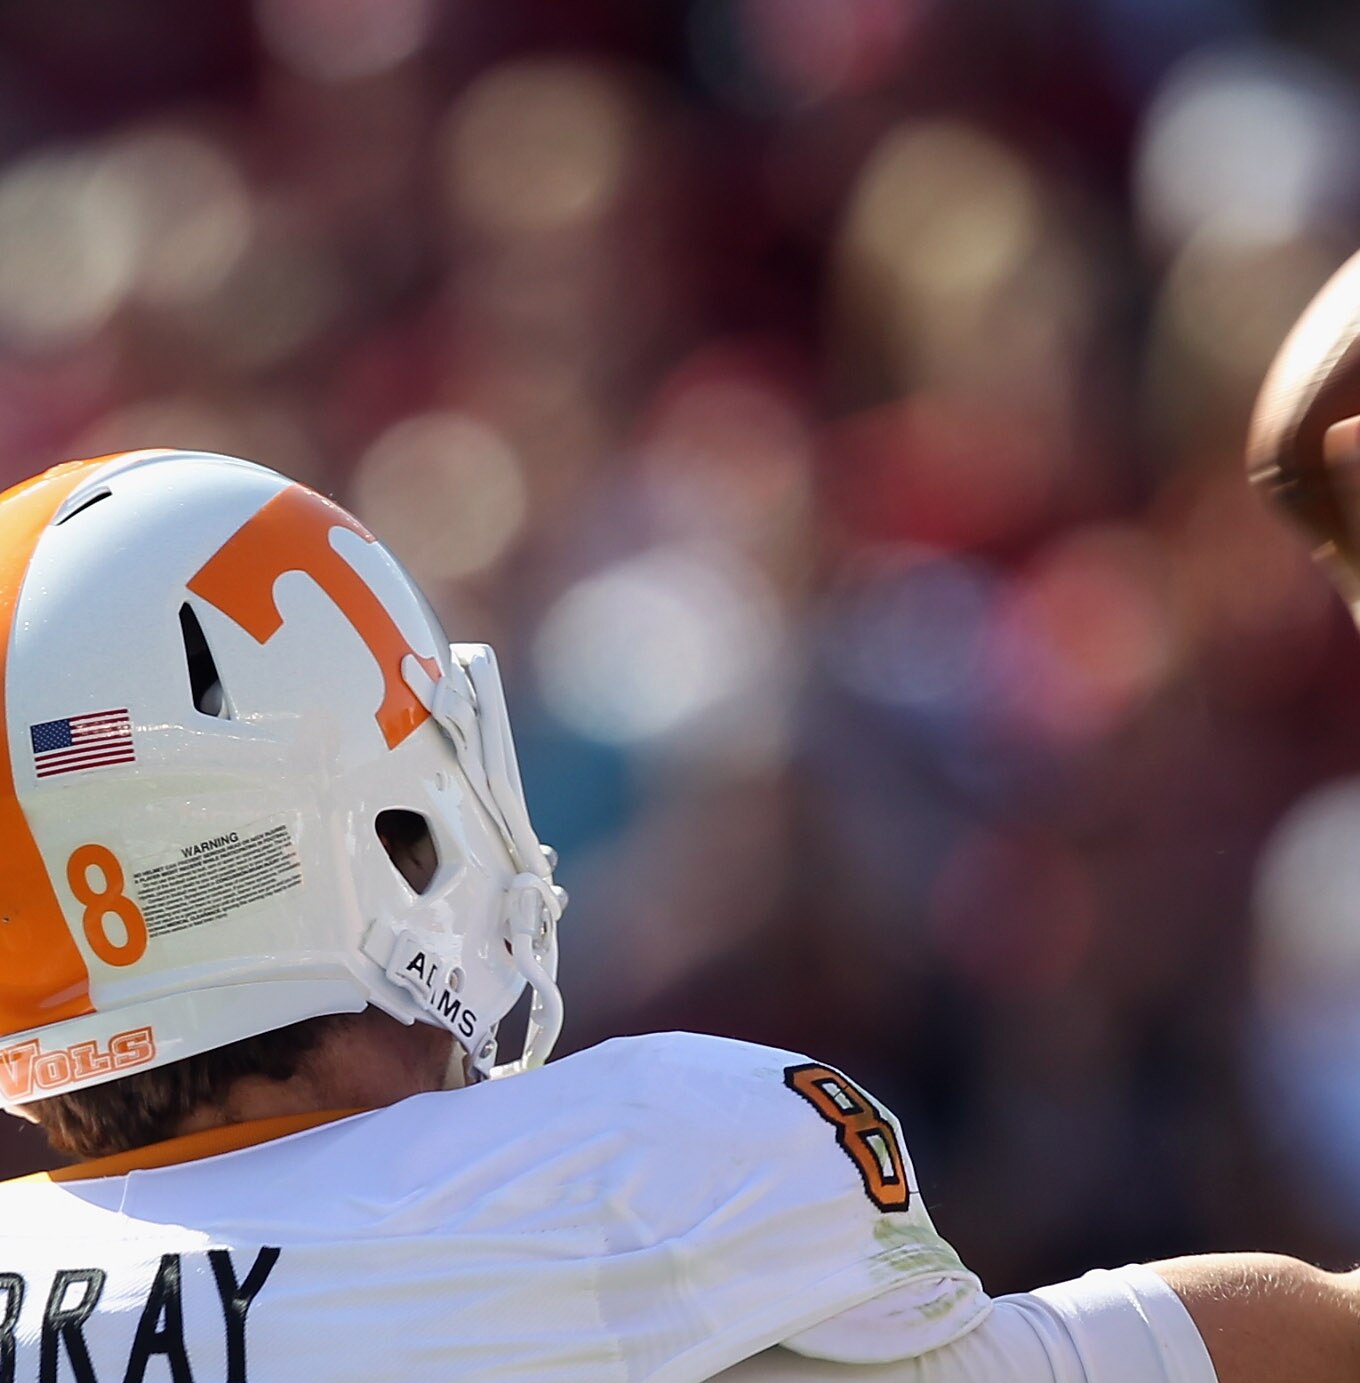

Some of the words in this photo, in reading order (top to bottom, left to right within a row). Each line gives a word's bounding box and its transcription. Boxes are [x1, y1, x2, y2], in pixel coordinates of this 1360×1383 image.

[185, 481, 443, 751] T
[66, 843, 148, 968] 8
[180, 831, 239, 858] WARNING
[782, 1062, 911, 1214] 8
